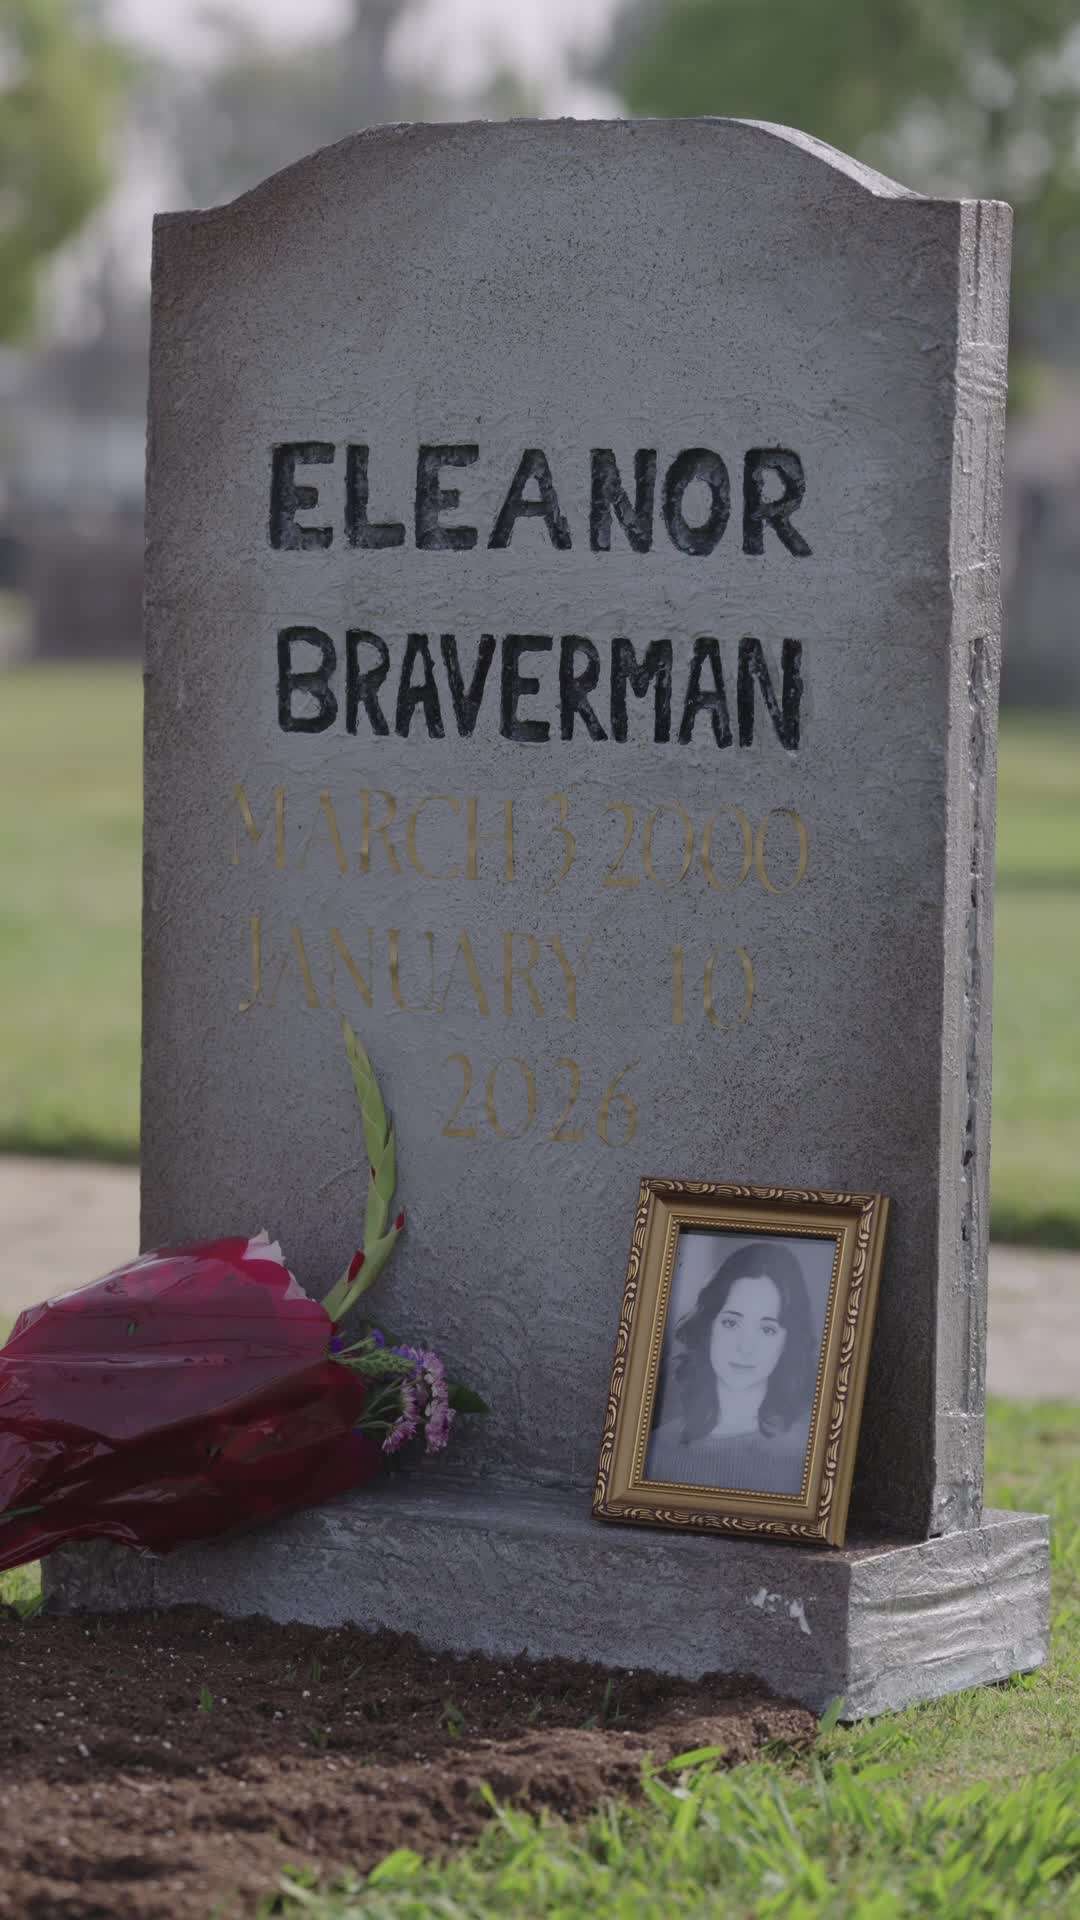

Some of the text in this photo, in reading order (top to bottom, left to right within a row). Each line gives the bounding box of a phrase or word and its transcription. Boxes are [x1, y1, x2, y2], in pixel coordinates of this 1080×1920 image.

[269, 440, 814, 557] ELEANOR
[276, 626, 804, 751] BRAVERMAN
[231, 783, 811, 896] MARCH 3 2000
[237, 914, 757, 1033] JANUARY 10
[441, 1051, 643, 1149] 2026
